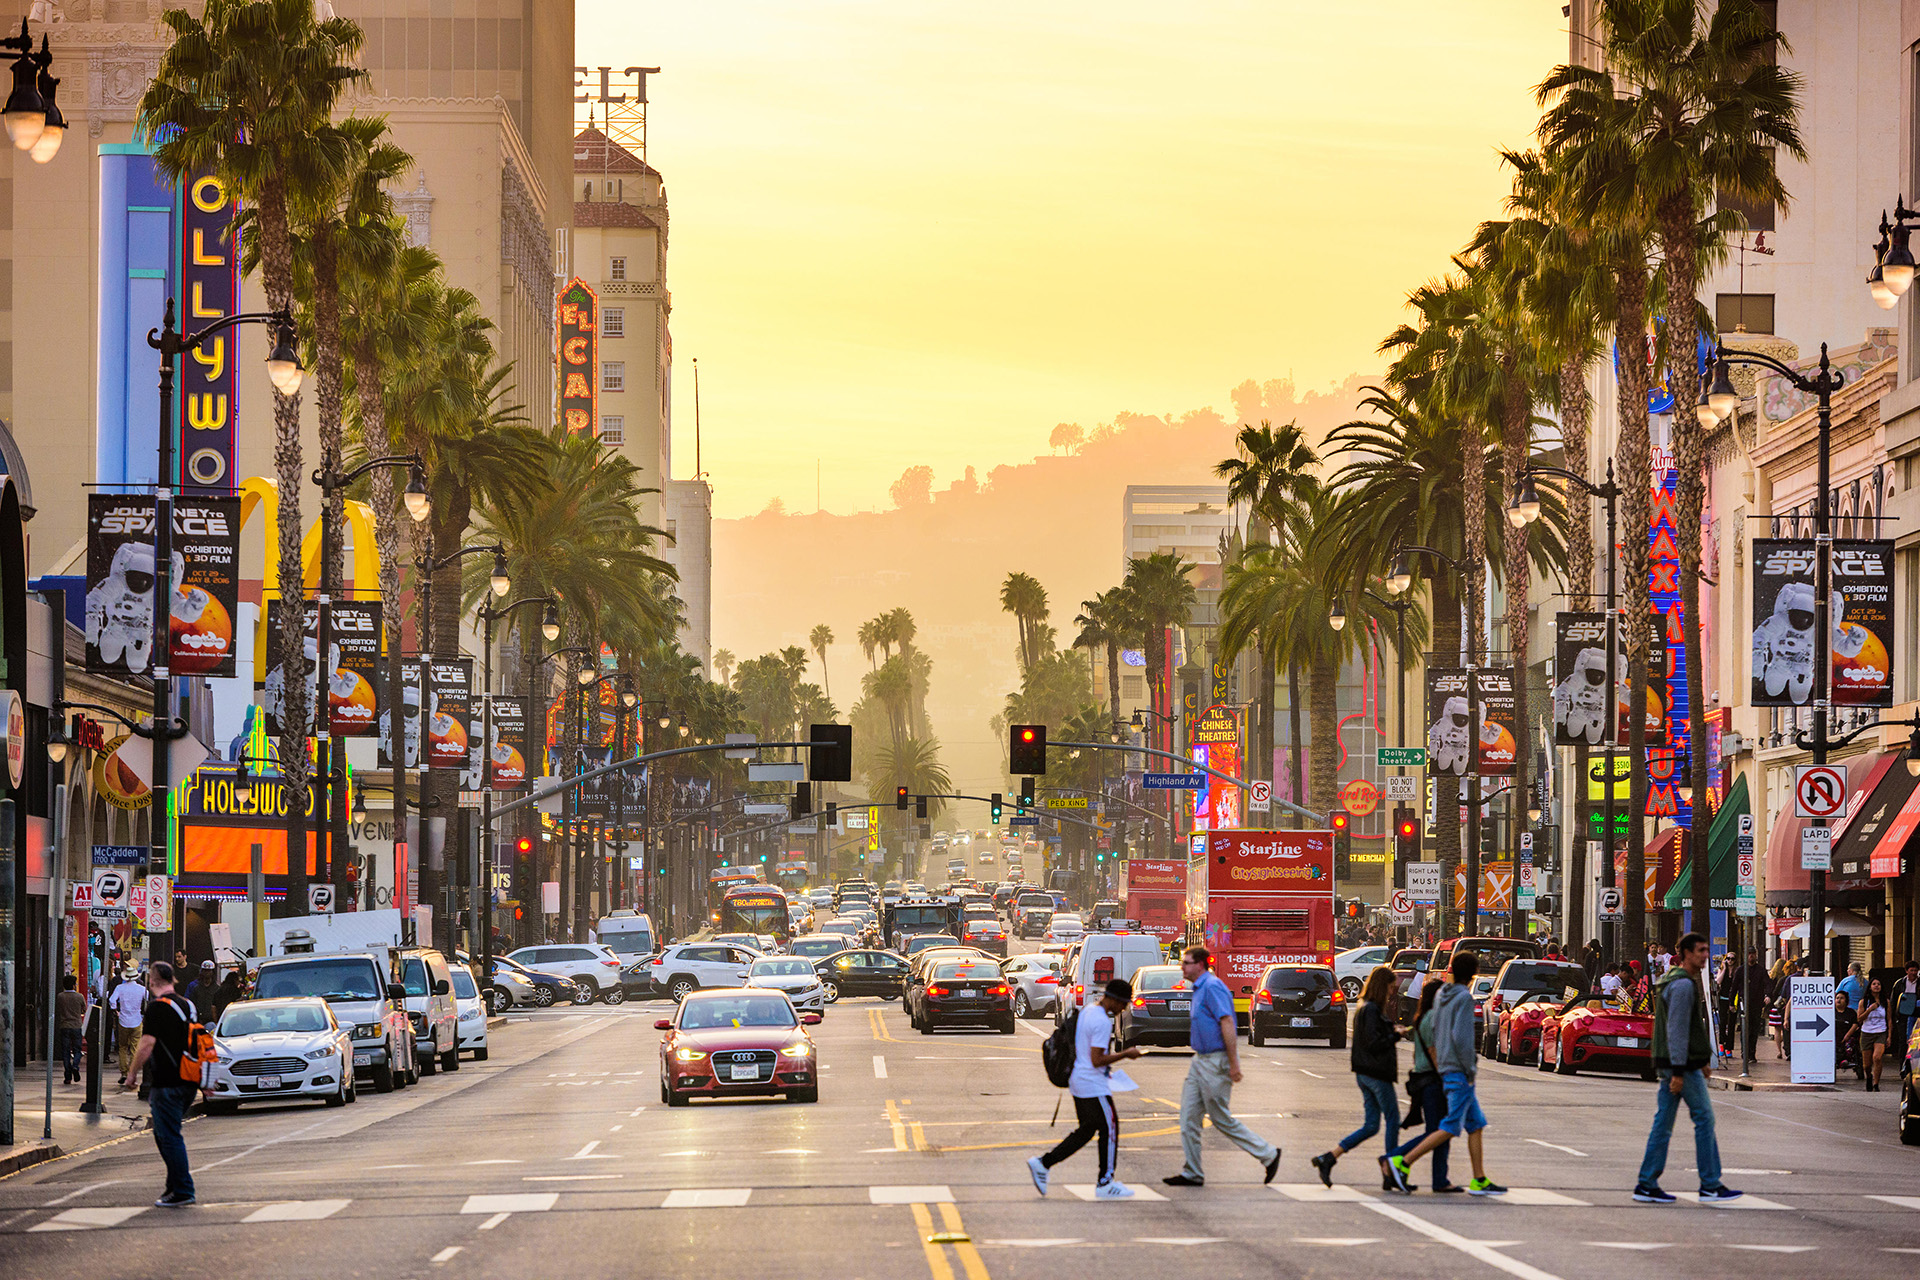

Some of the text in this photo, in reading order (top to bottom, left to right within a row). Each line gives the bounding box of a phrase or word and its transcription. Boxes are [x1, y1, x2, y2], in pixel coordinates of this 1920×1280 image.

[561, 303, 593, 332] EL
[188, 174, 227, 485] OLLYWO
[1649, 485, 1678, 595] WAX
[183, 545, 233, 554] EXHIBITION
[1843, 585, 1888, 593] EXHIBITION
[471, 707, 523, 717] PACE
[1210, 709, 1224, 719] TCL
[1201, 720, 1233, 730] CHINESE
[1199, 731, 1236, 742] THEATRES
[1385, 750, 1407, 761] Dolby
[1148, 776, 1200, 787] Highland Av
[1390, 778, 1413, 786] DO NOT
[1337, 786, 1360, 800] ard
[104, 791, 130, 808] Since
[870, 811, 878, 846] INN
[1803, 830, 1830, 838] LAPD
[94, 847, 138, 857] McCadden
[1358, 854, 1386, 862] MERCHAN
[75, 886, 92, 900] AT
[131, 887, 146, 900] AT
[1227, 955, 1317, 963] 1-855-4LAHOPON
[1232, 964, 1264, 972] 1-855-
[1793, 983, 1833, 993] PUBLIC
[1792, 996, 1834, 1006] PARKING
